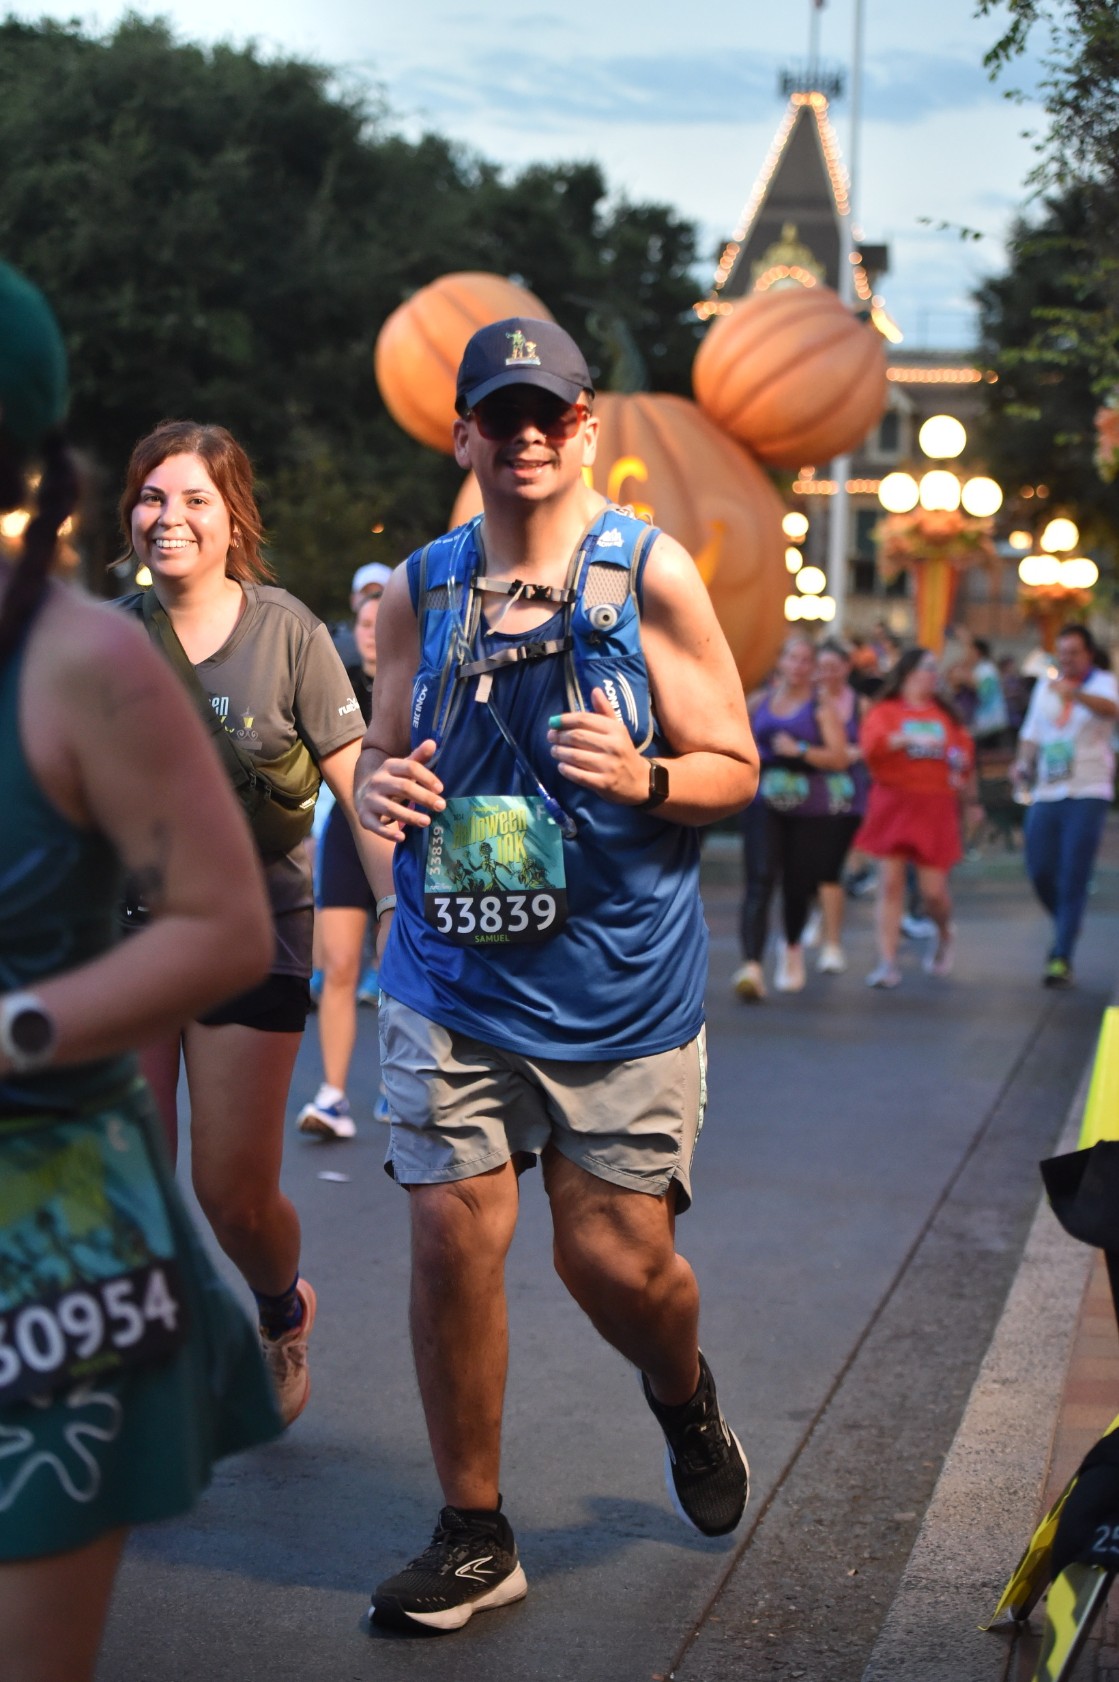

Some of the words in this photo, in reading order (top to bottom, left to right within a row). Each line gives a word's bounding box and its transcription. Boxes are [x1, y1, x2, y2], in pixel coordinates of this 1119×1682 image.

[429, 825, 445, 876] 33839
[434, 893, 557, 934] 33839
[474, 934, 511, 943] SAMUEL
